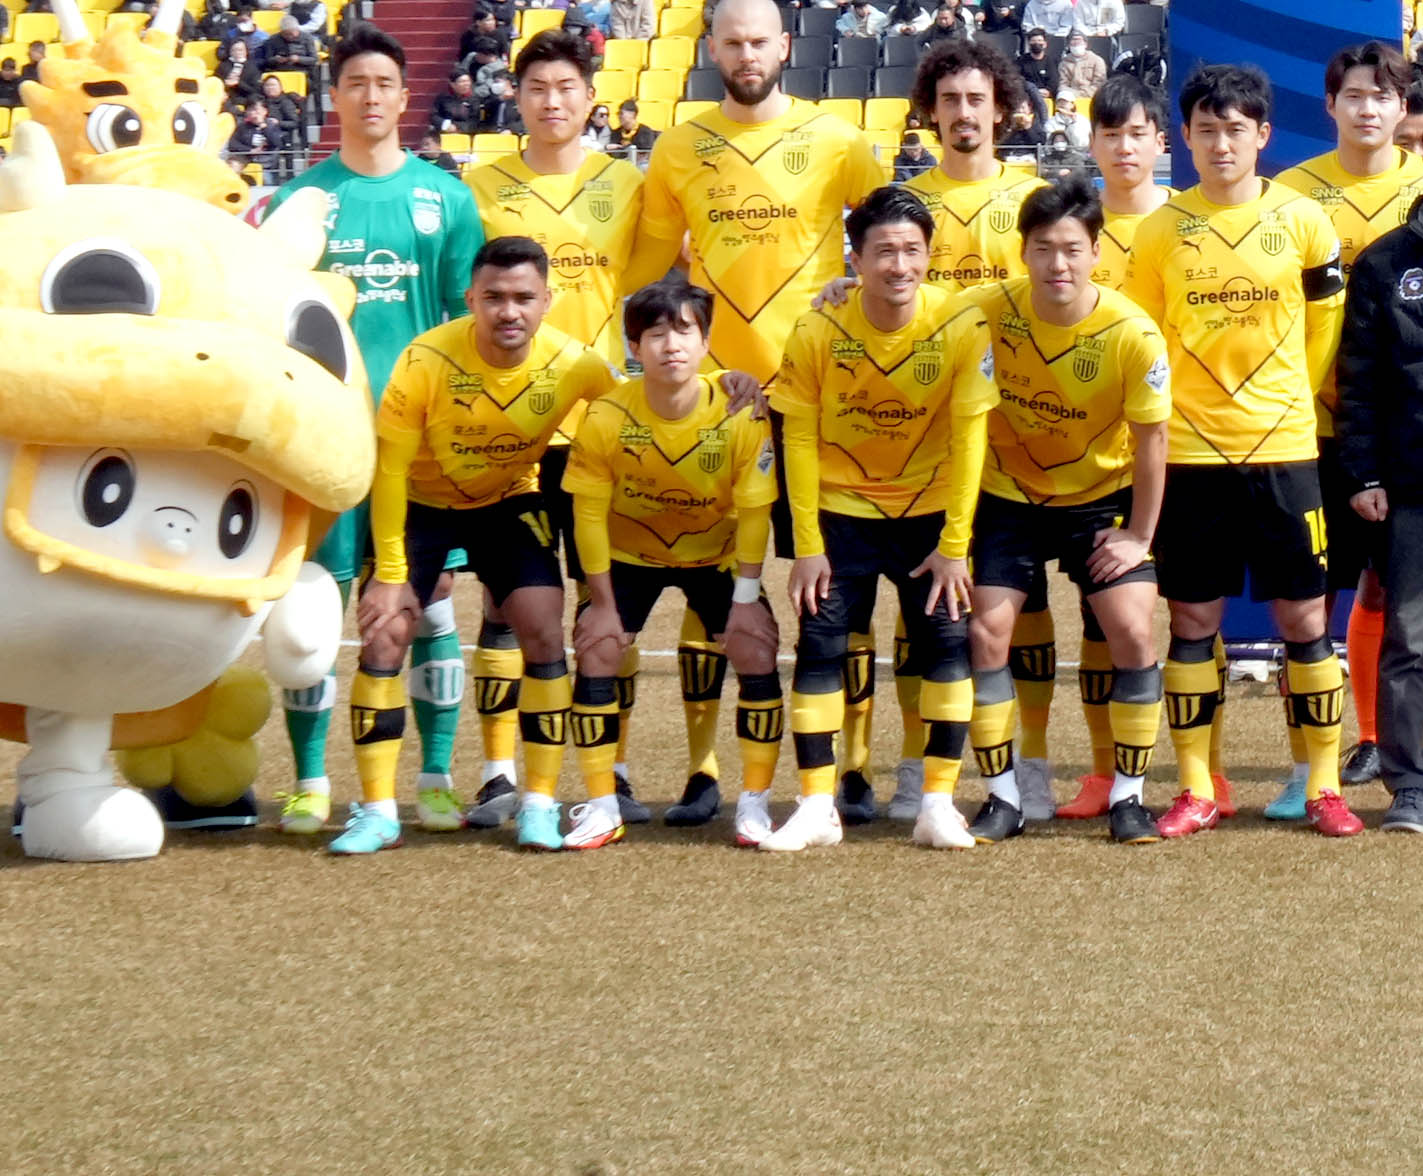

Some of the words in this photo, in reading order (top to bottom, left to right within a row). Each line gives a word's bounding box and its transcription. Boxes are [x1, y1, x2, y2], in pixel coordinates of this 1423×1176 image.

[708, 204, 798, 222] Greenable
[550, 252, 609, 268] enable
[927, 264, 1008, 281] Greenable
[1185, 267, 1218, 281] 포스코
[1186, 286, 1279, 305] Greenable
[1000, 388, 1088, 420] Greenable
[624, 486, 717, 508] Greenable
